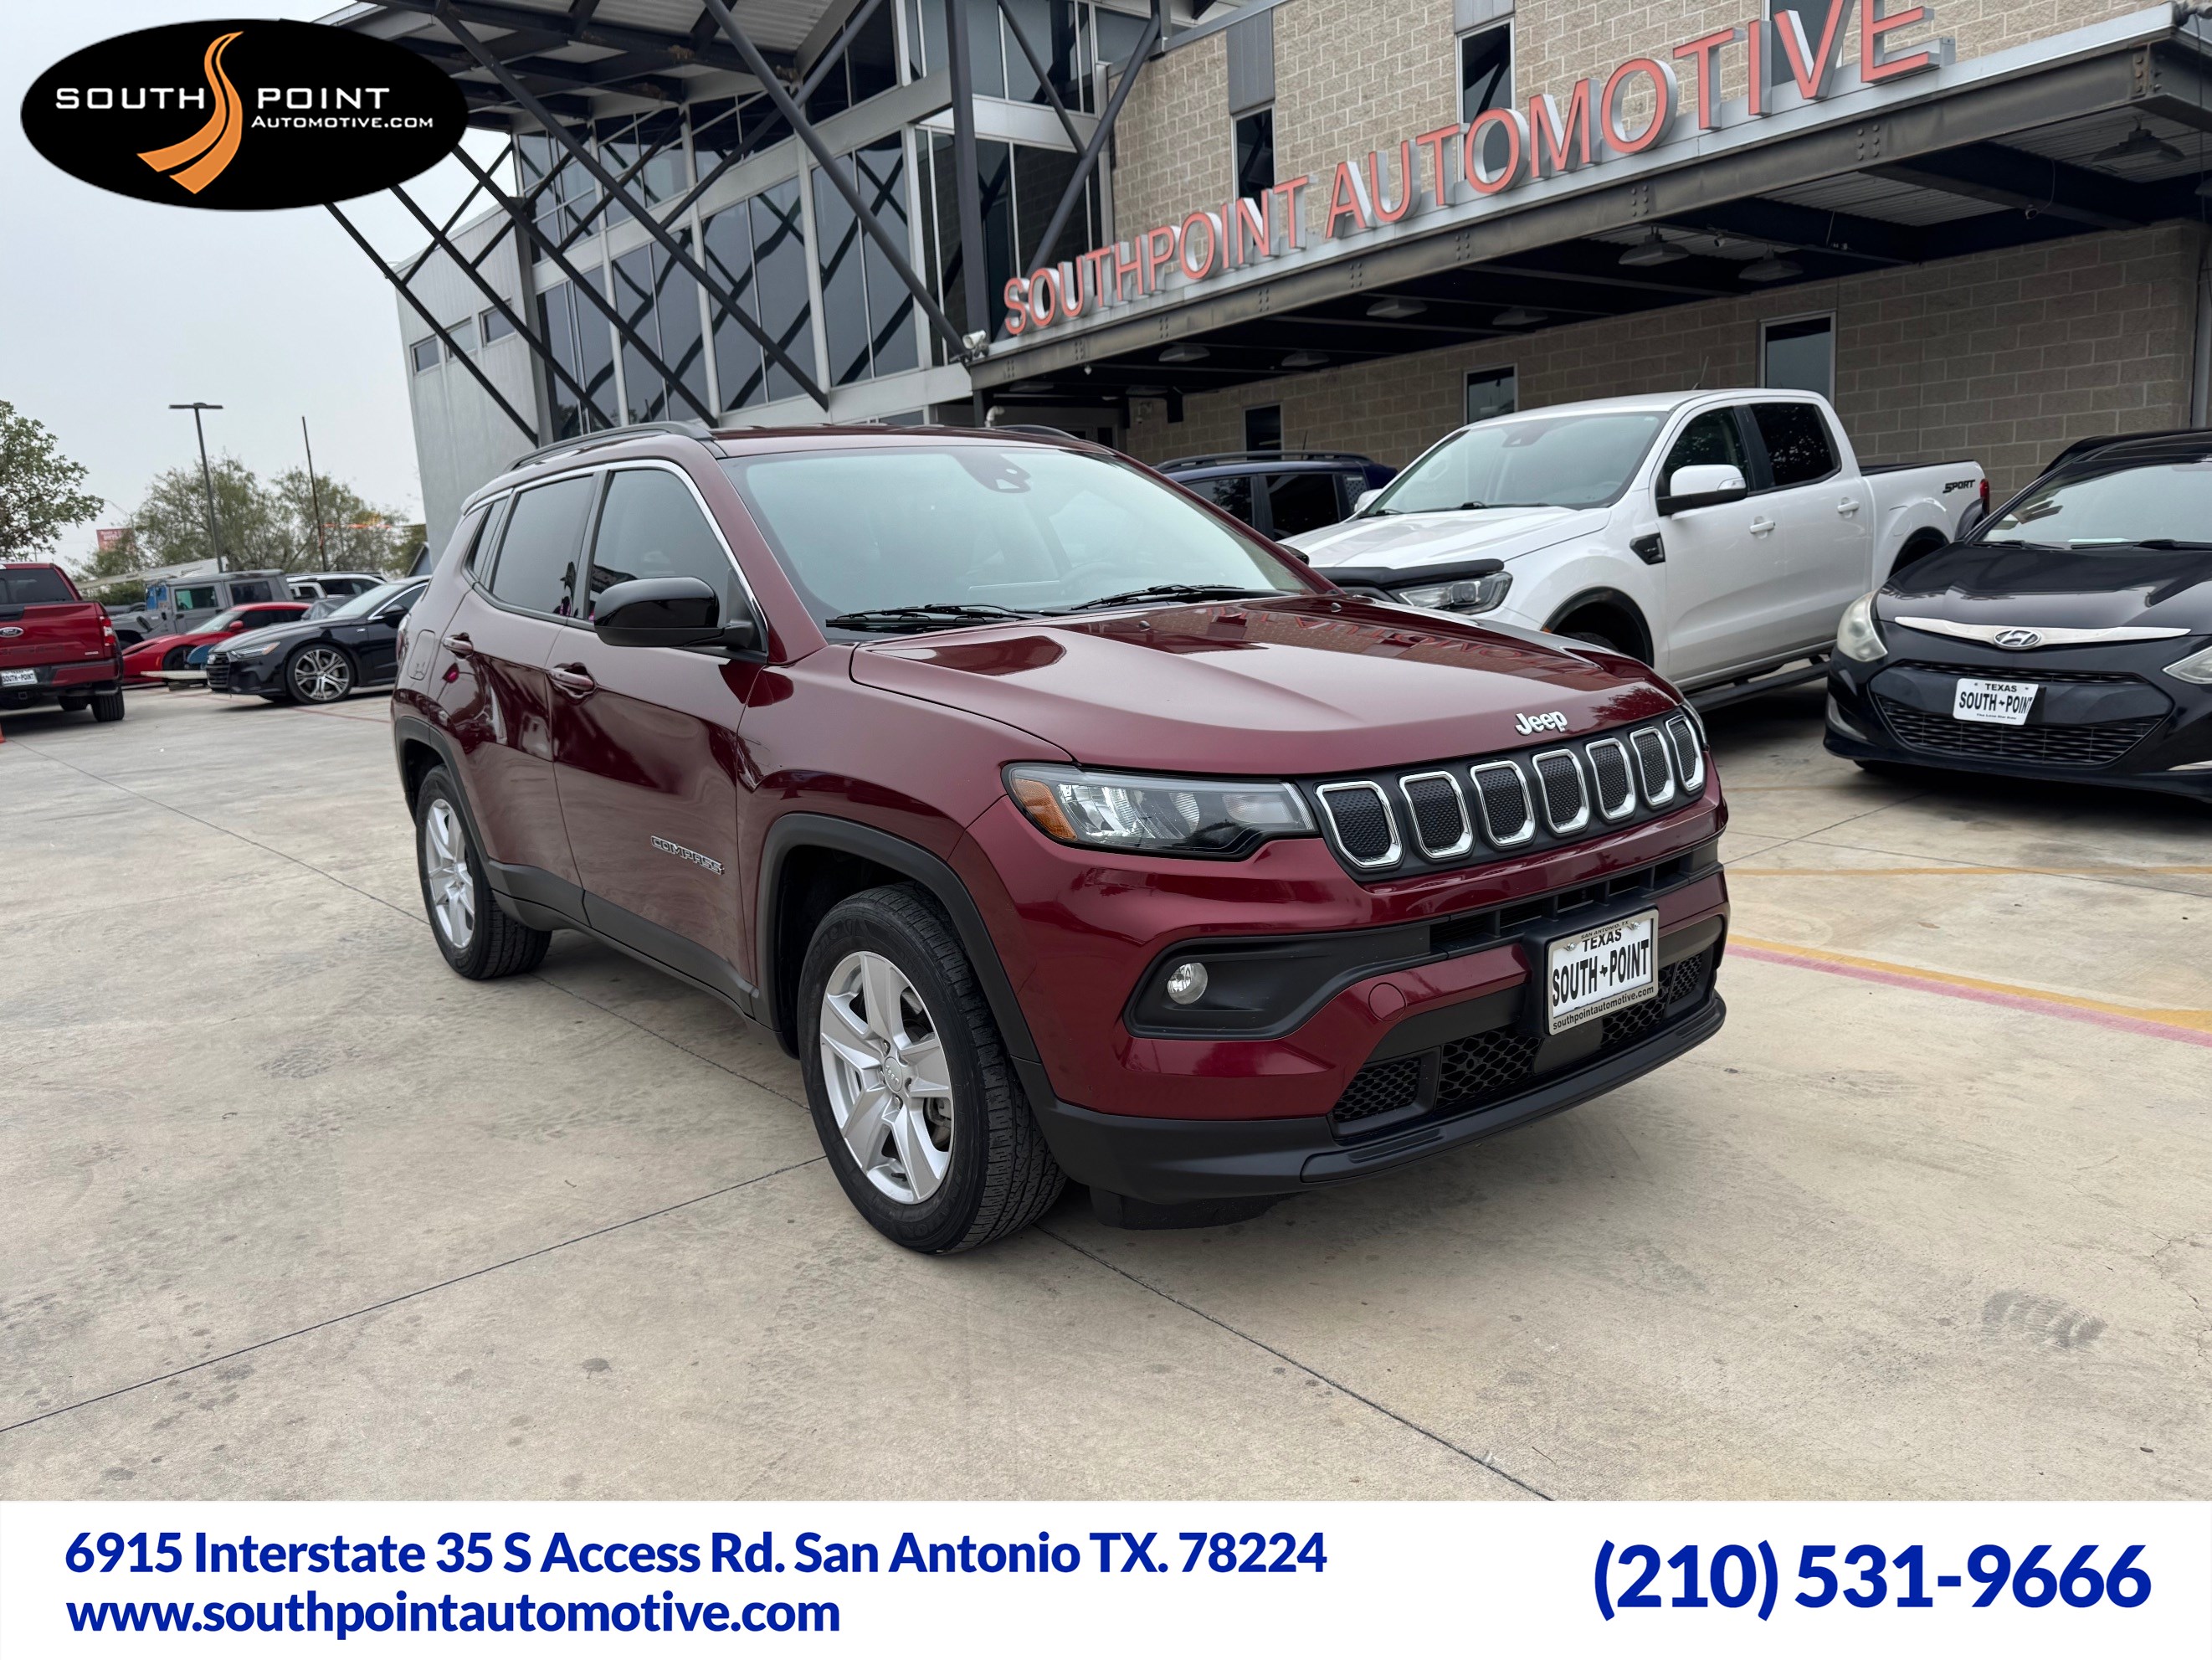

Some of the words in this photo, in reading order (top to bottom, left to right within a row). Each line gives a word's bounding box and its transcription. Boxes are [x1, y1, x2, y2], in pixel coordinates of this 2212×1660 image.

[1004, 174, 1310, 335] SOUTHPOINT
[1326, 0, 1931, 239] AUTOMOTIVE
[1943, 479, 1976, 494] SPORT
[1985, 682, 2017, 692] TEXAS
[1959, 691, 1997, 712] SOUTH
[2005, 695, 2033, 714] POINT
[1515, 711, 1568, 736] Jeep
[650, 835, 725, 876] COMPASS
[1582, 928, 1622, 953] TEXAS
[1553, 955, 1598, 1007] SOUTH
[1609, 939, 1650, 986] POINT
[1553, 986, 1654, 1030] southpointautomotive.com
